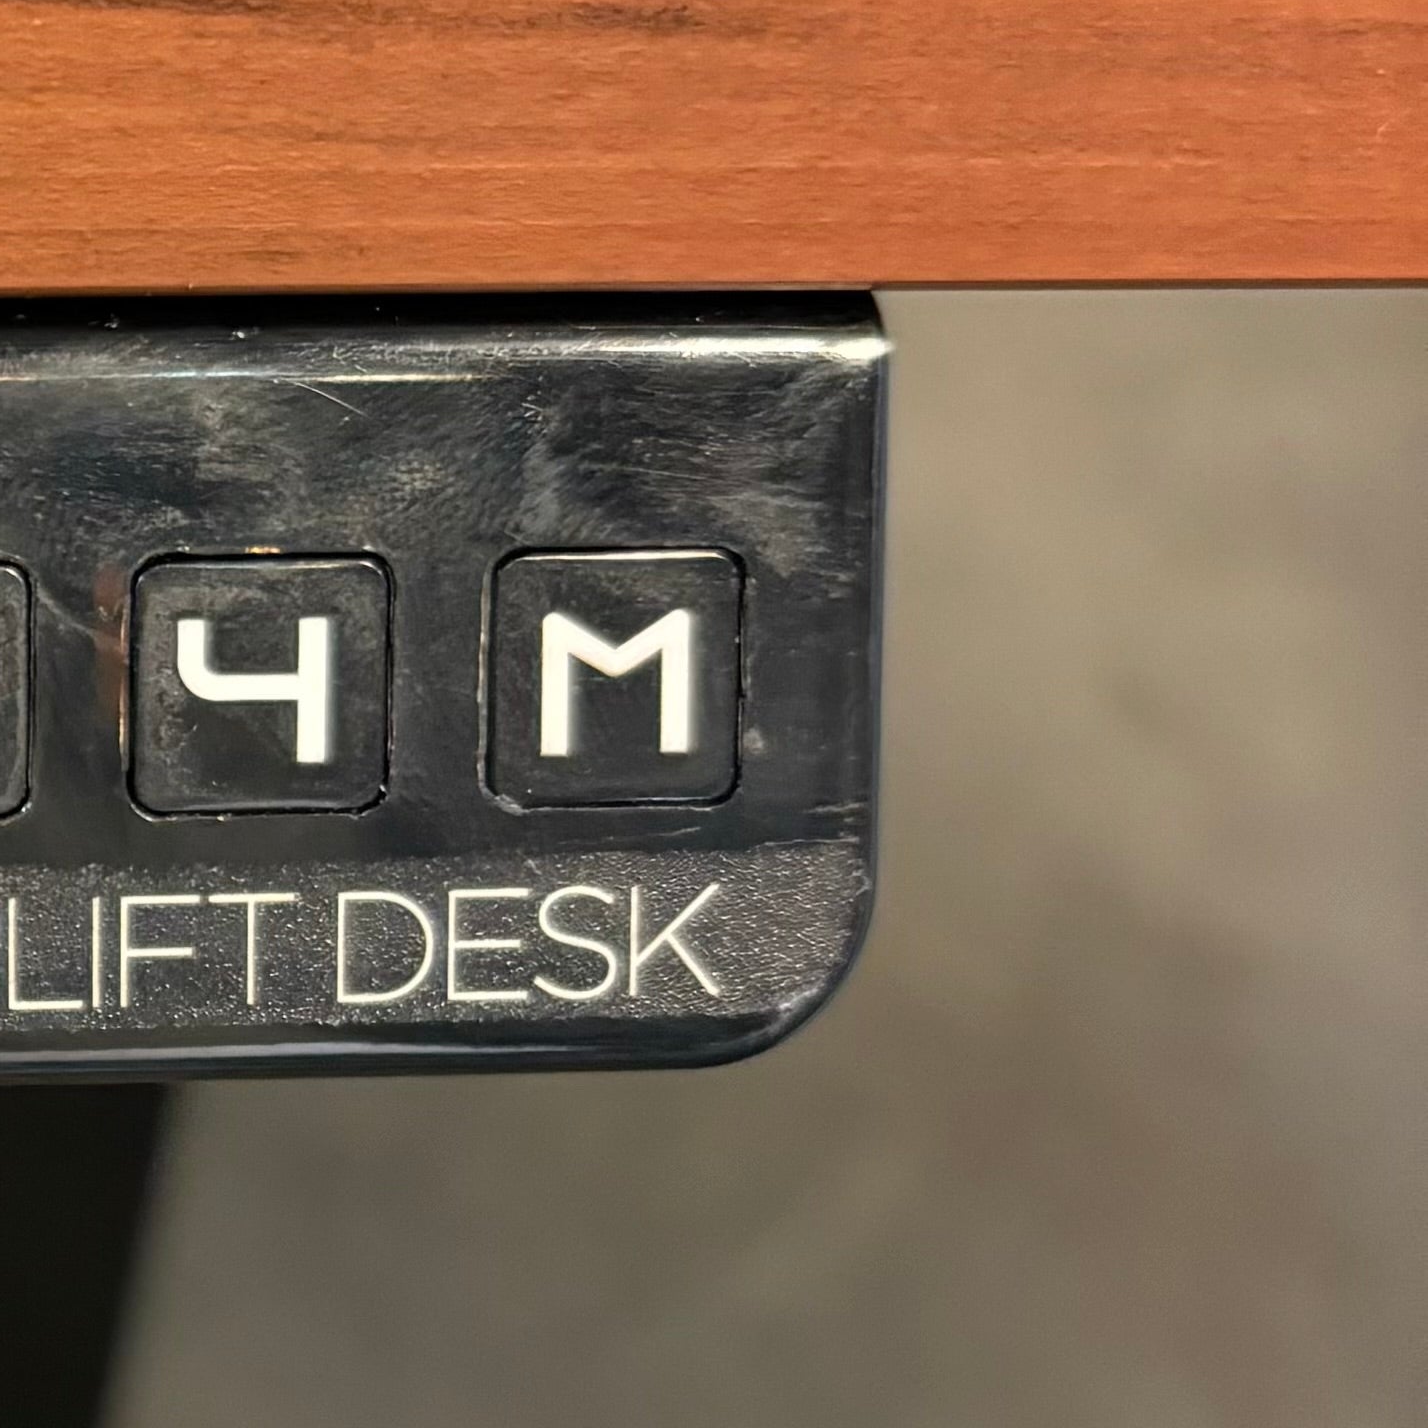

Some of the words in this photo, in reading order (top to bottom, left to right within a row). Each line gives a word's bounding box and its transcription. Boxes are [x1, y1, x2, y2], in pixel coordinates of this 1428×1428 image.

[176, 615, 331, 765] 4
[539, 607, 695, 758] M
[334, 880, 732, 1010] DESK
